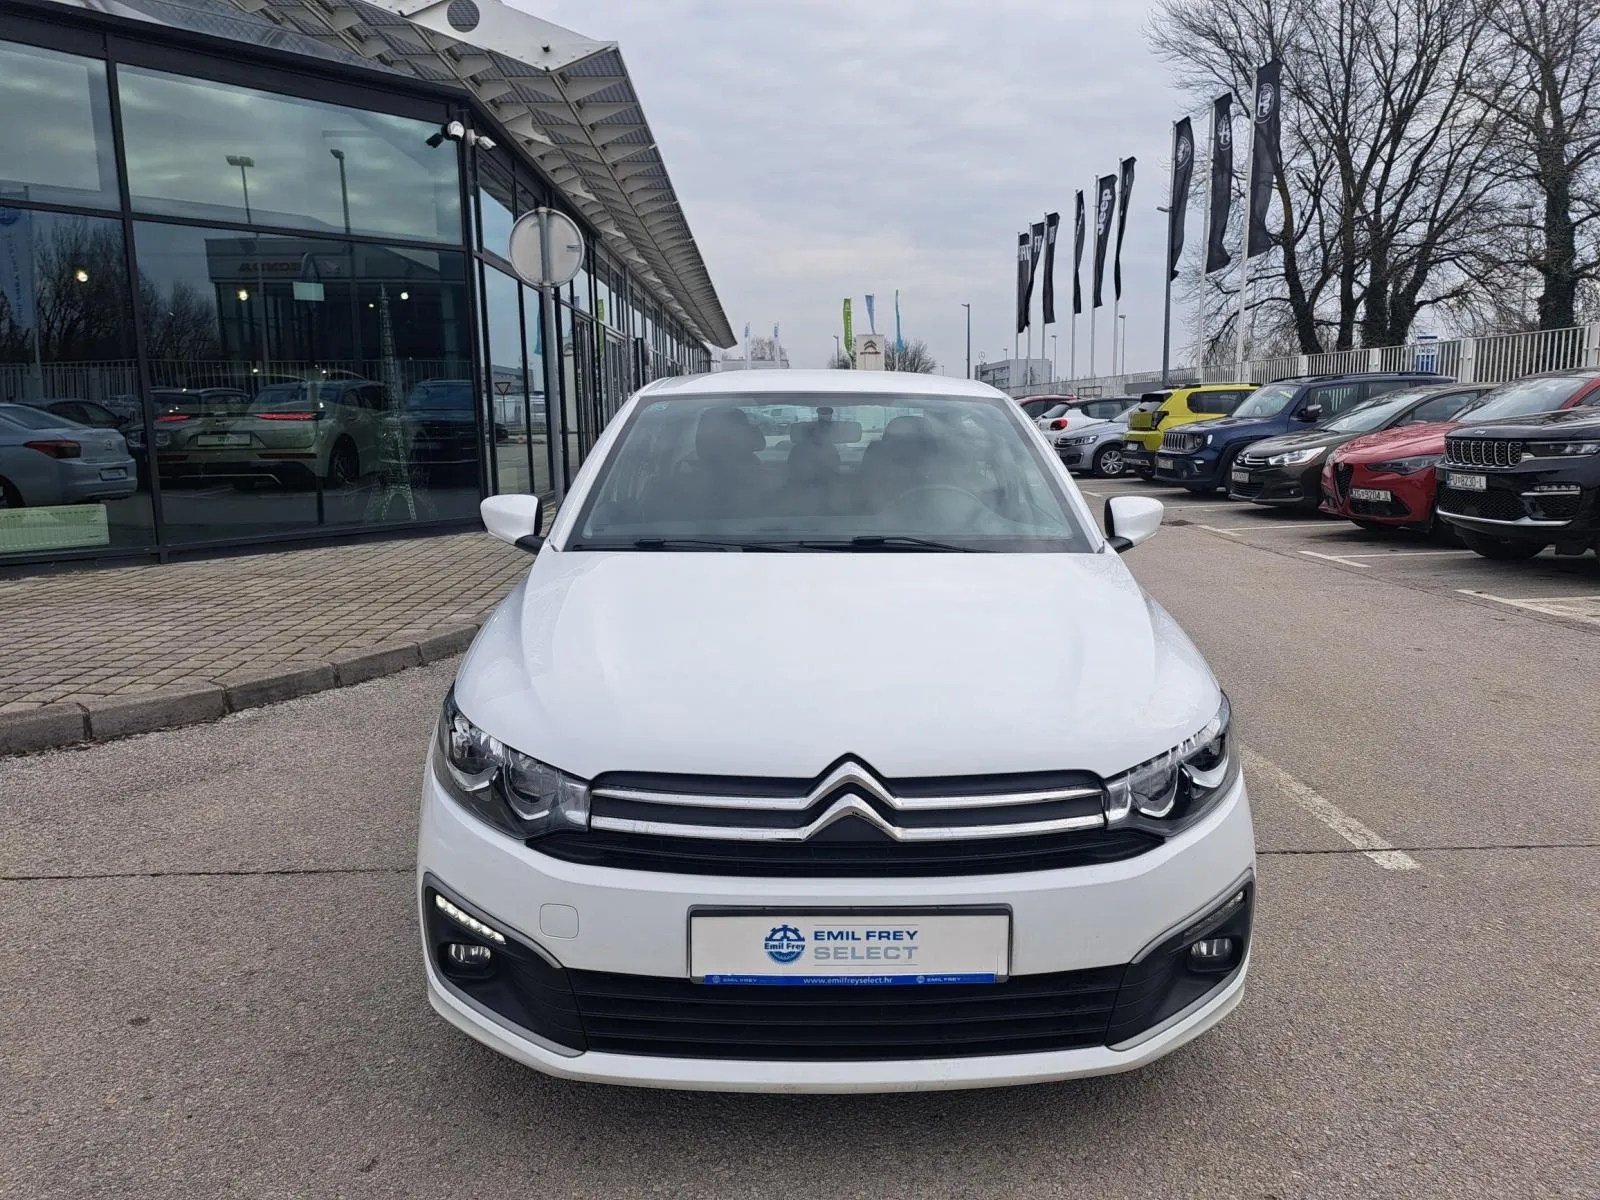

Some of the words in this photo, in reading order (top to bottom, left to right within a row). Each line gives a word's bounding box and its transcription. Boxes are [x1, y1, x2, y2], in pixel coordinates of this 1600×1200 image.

[813, 930, 861, 941] EMIL
[865, 930, 919, 941] FREY
[764, 942, 784, 950] Emil
[786, 942, 806, 952] Frey
[813, 946, 918, 960] SELECT
[803, 976, 893, 985] www.emilfreyselect.hr
